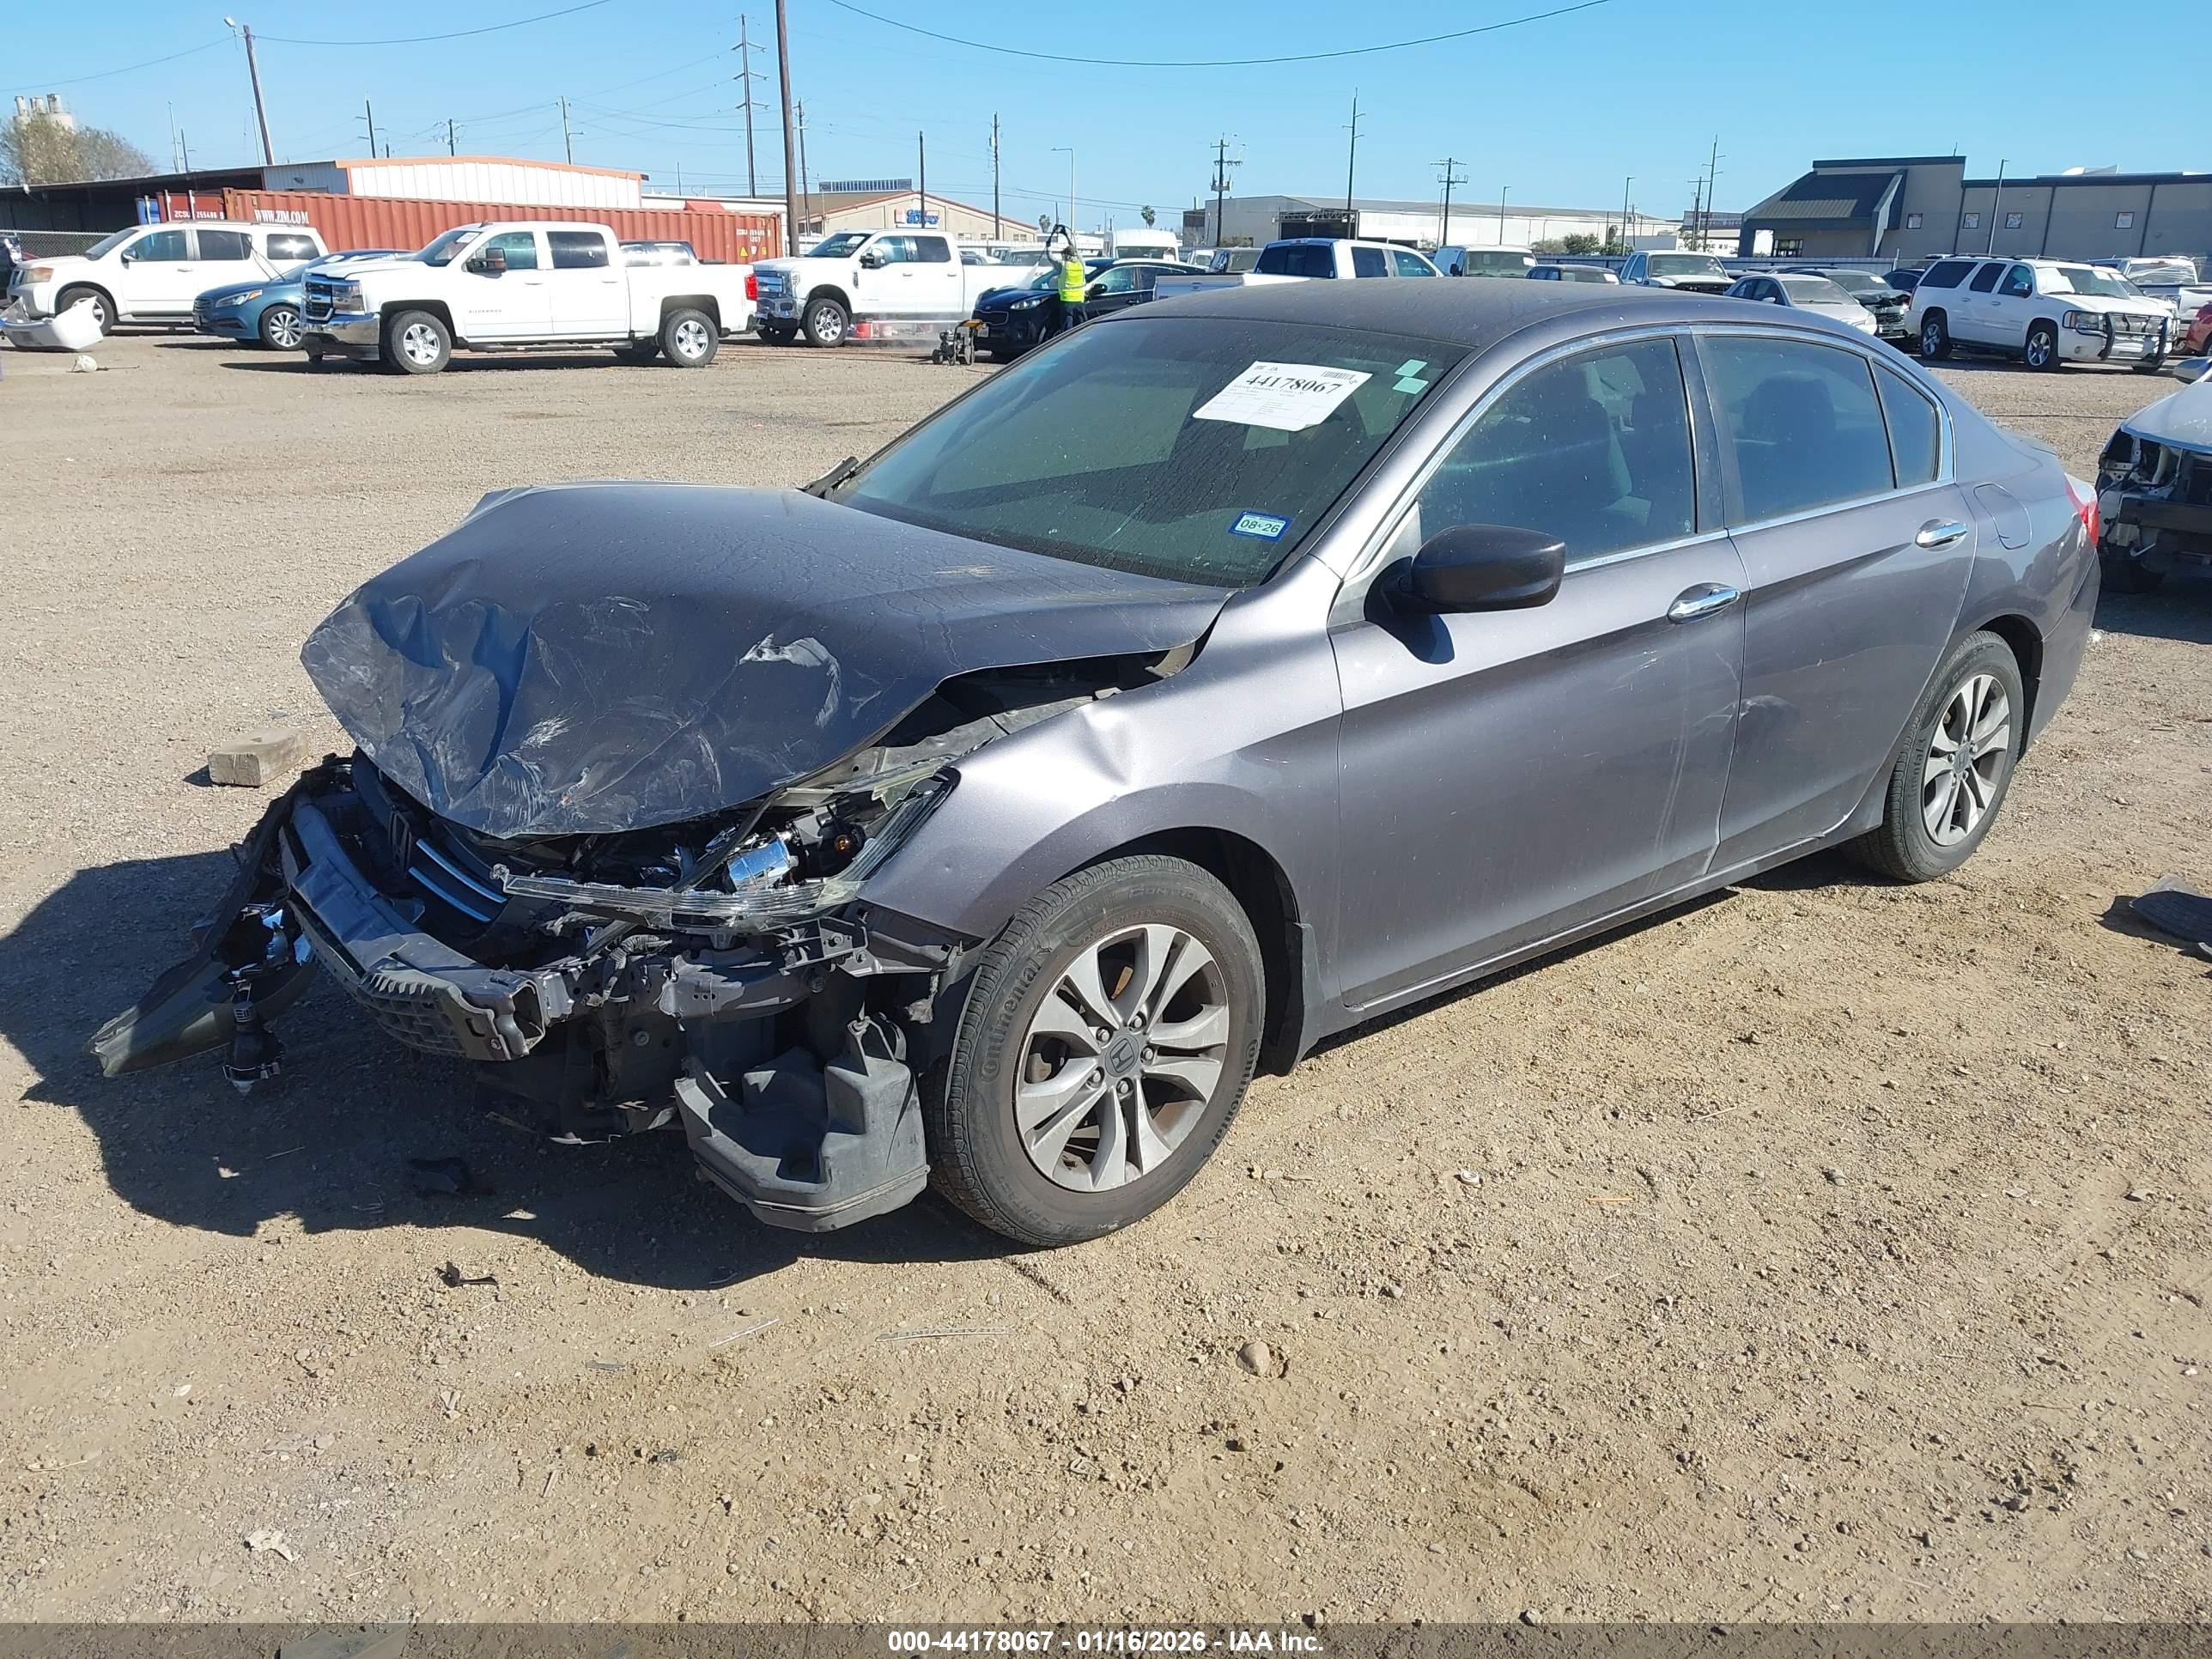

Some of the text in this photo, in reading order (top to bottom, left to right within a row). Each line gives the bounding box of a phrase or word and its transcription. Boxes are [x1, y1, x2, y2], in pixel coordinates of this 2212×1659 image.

[254, 210, 310, 224] WWW.ZIM.COM
[1245, 374, 1342, 395] 44178067
[1240, 520, 1281, 533] 08 26
[979, 953, 1044, 1083] Continental
